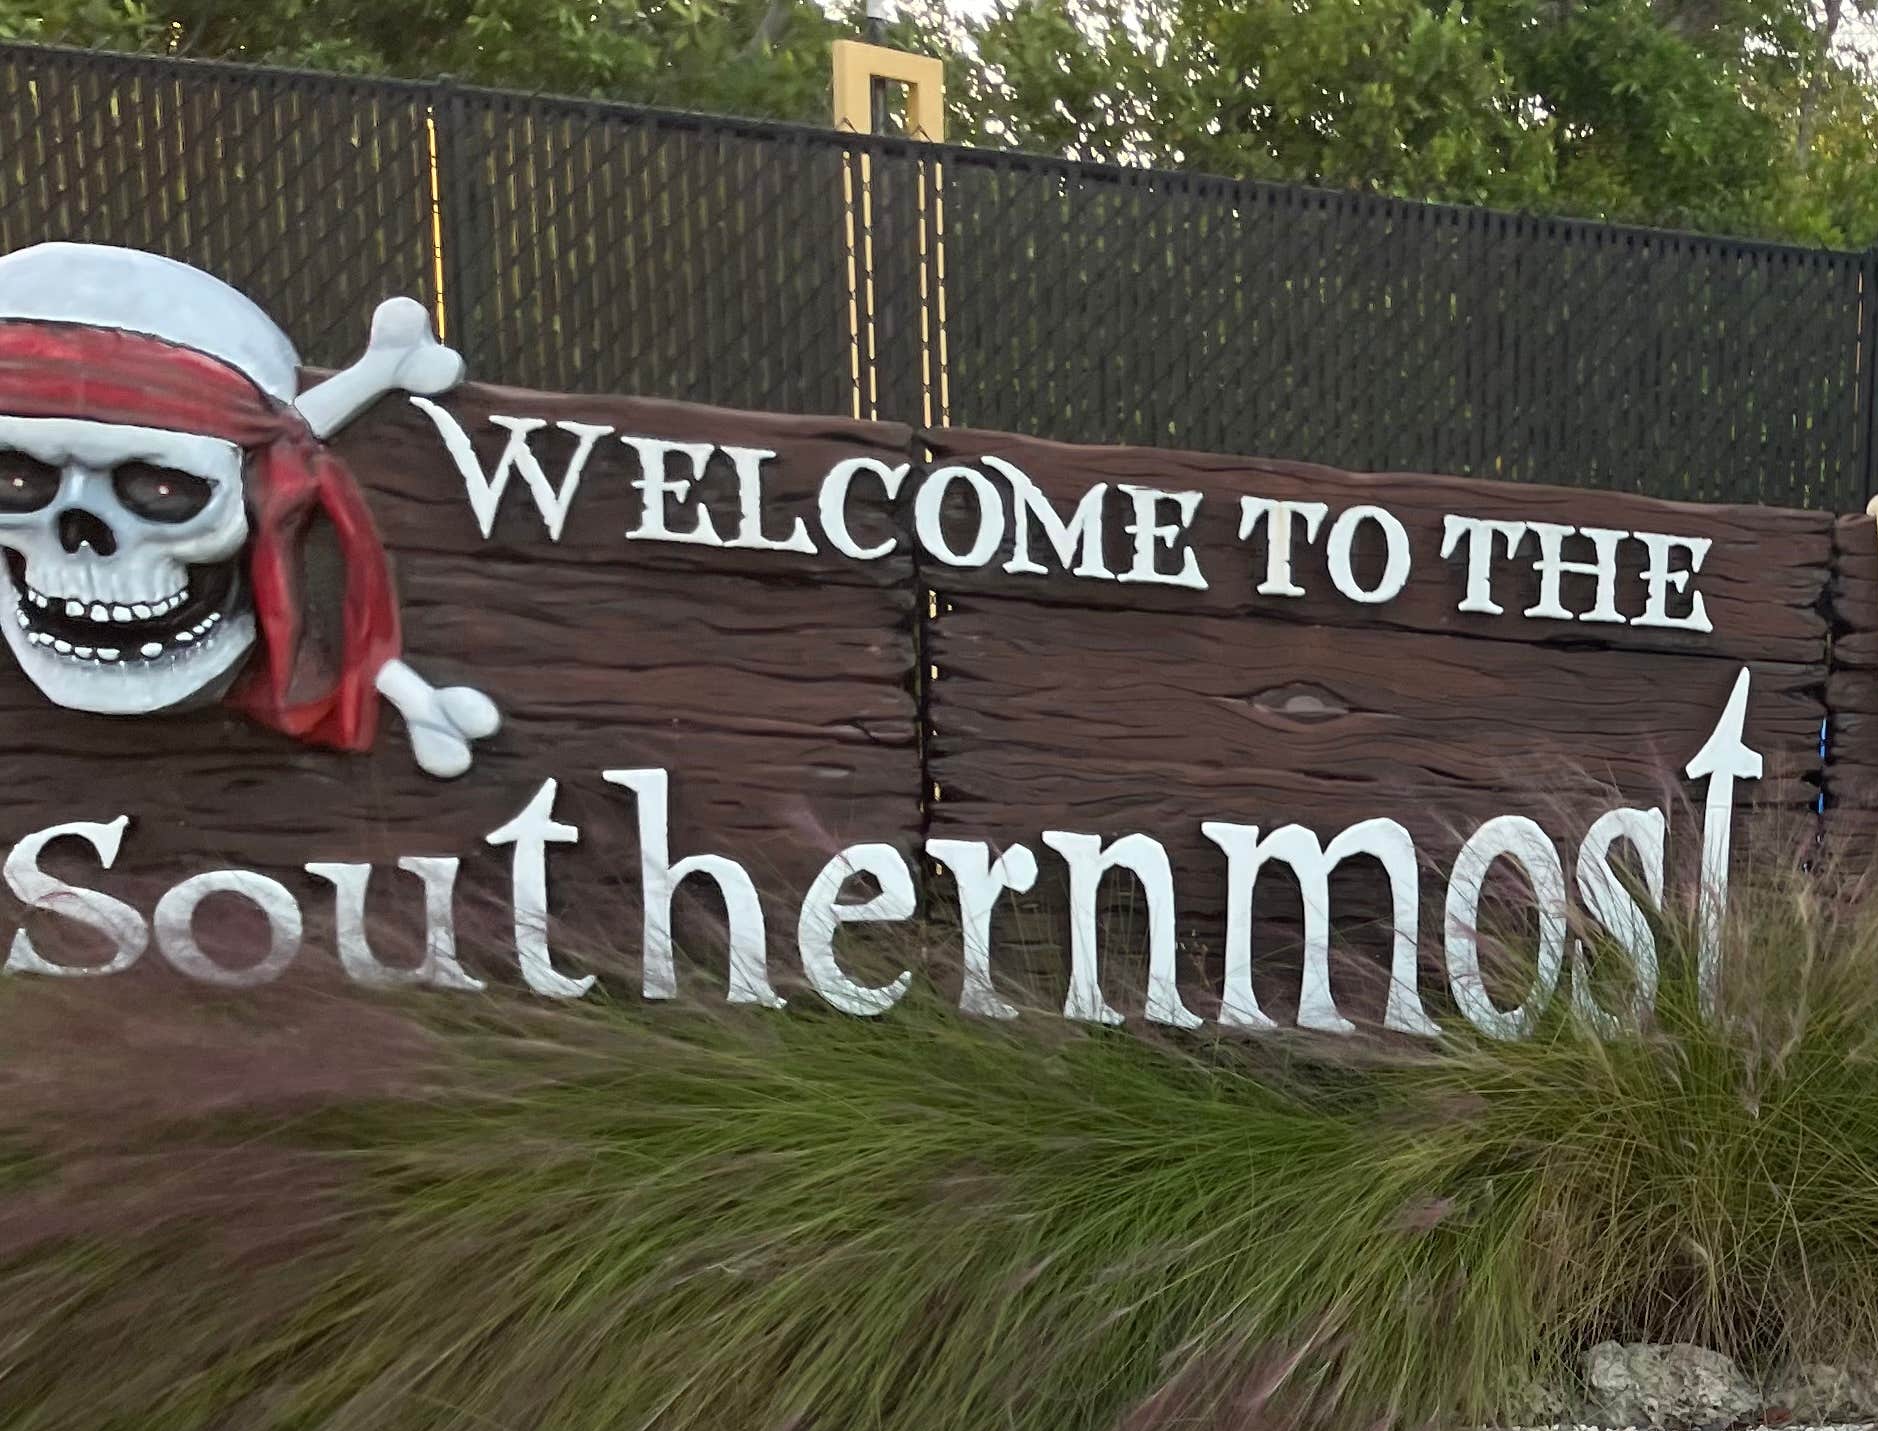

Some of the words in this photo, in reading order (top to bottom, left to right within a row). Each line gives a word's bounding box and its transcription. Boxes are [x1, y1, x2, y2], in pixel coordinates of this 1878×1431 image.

[409, 395, 1209, 590] WELCOME
[1238, 495, 1412, 604] TO
[1439, 513, 1713, 633] THE
